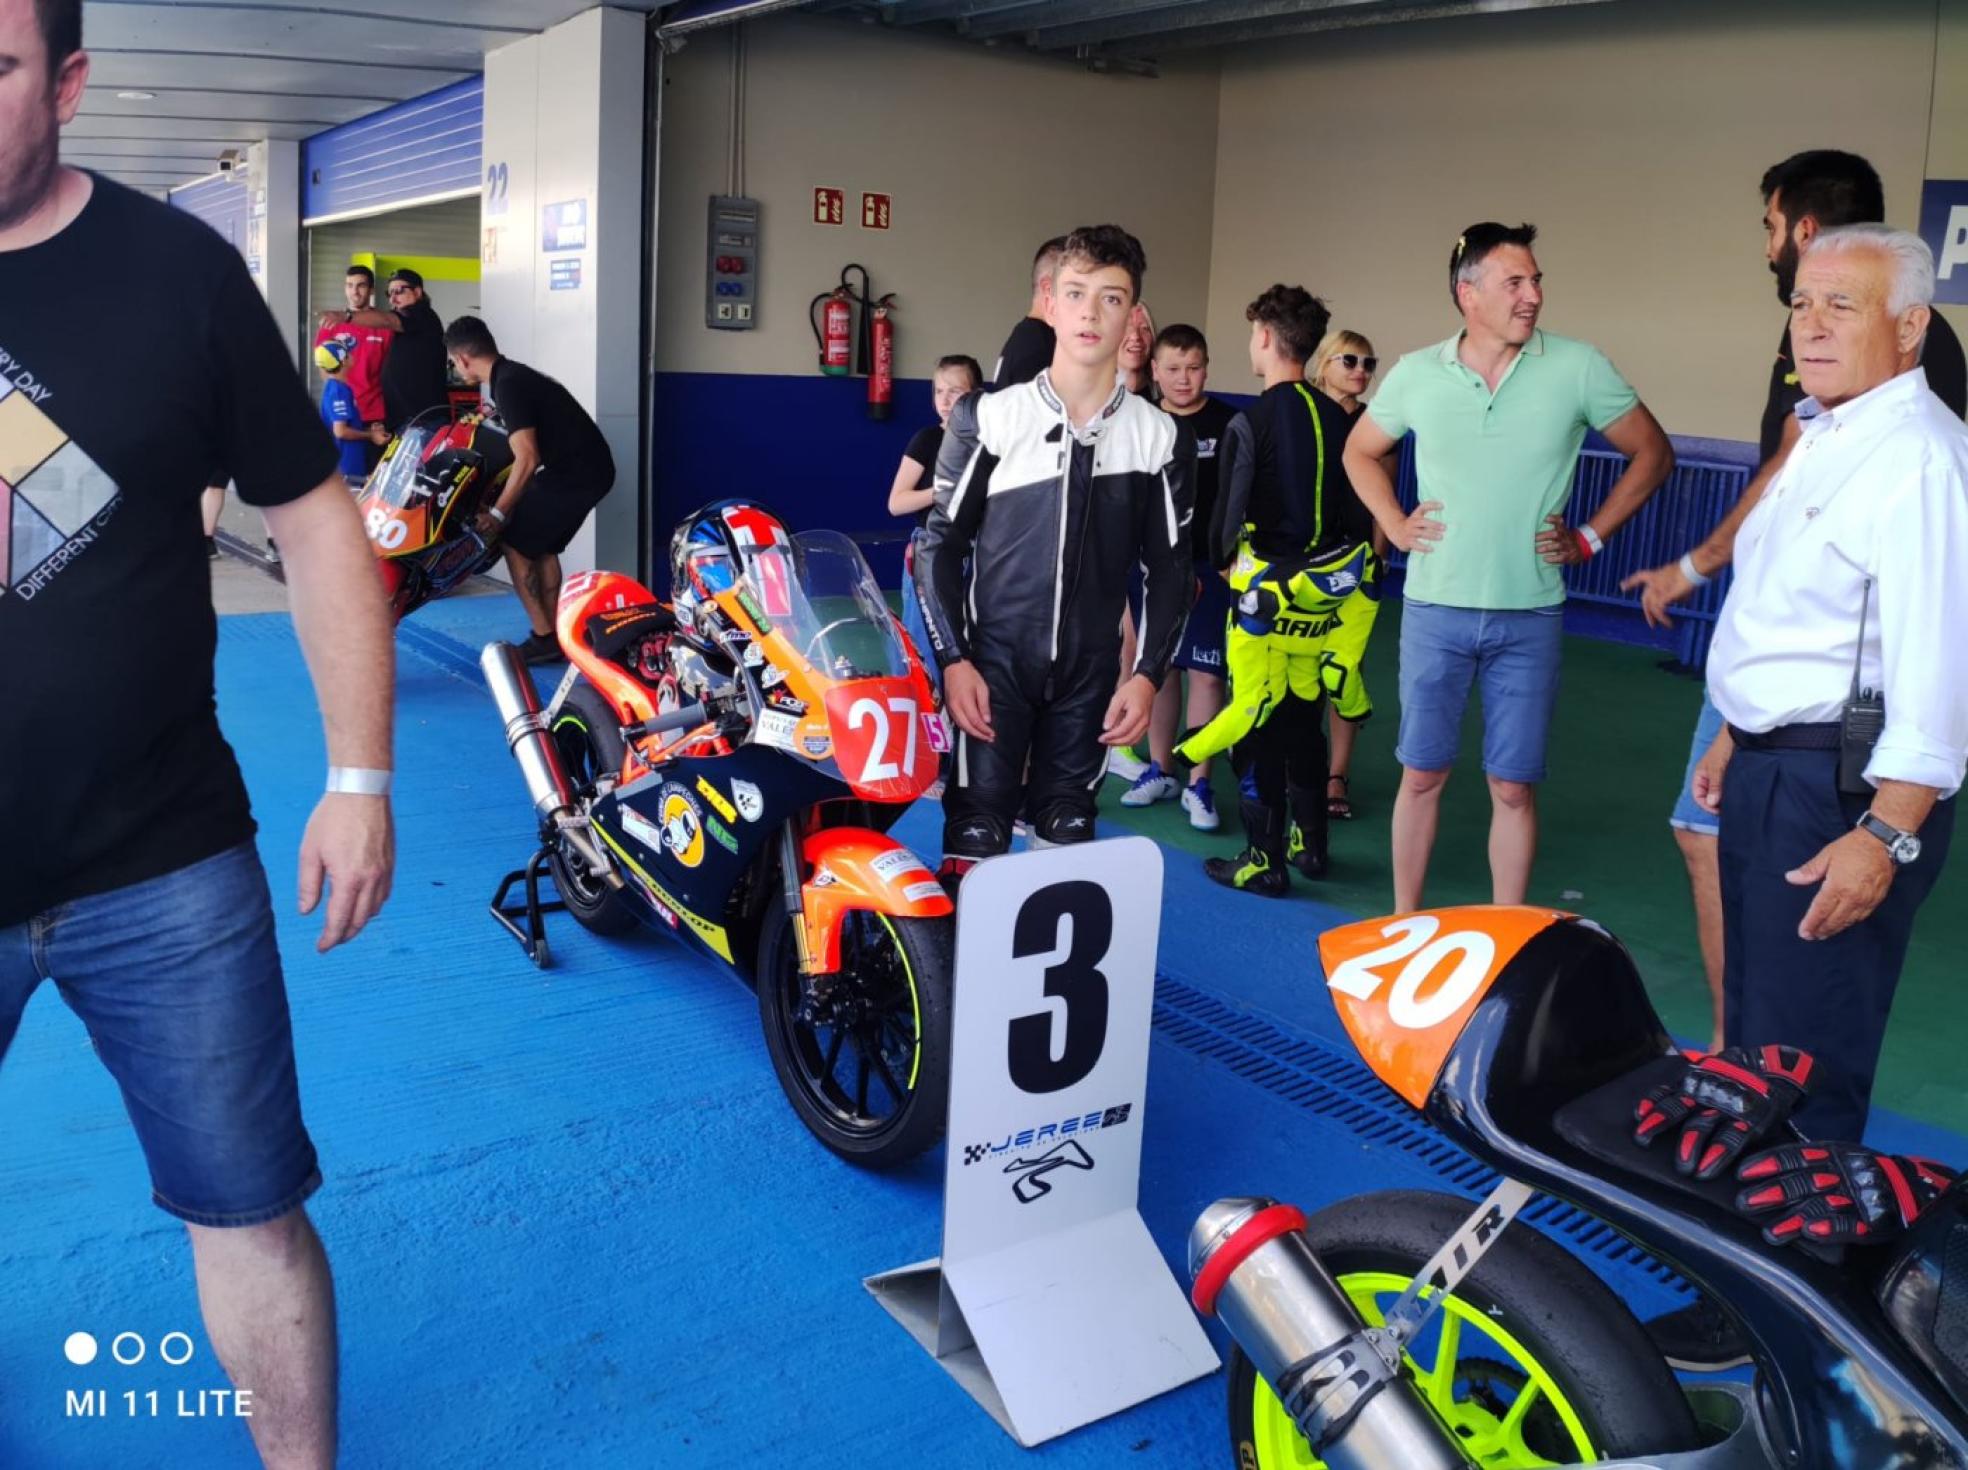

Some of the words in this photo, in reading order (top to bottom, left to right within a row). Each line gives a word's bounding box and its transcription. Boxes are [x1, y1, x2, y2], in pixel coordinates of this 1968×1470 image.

[14, 371, 53, 403] DAY
[16, 525, 98, 600] DIFFERENT
[366, 507, 407, 549] 80
[848, 698, 916, 783] 27
[1008, 880, 1113, 1094] 3
[1327, 915, 1495, 1029] 20
